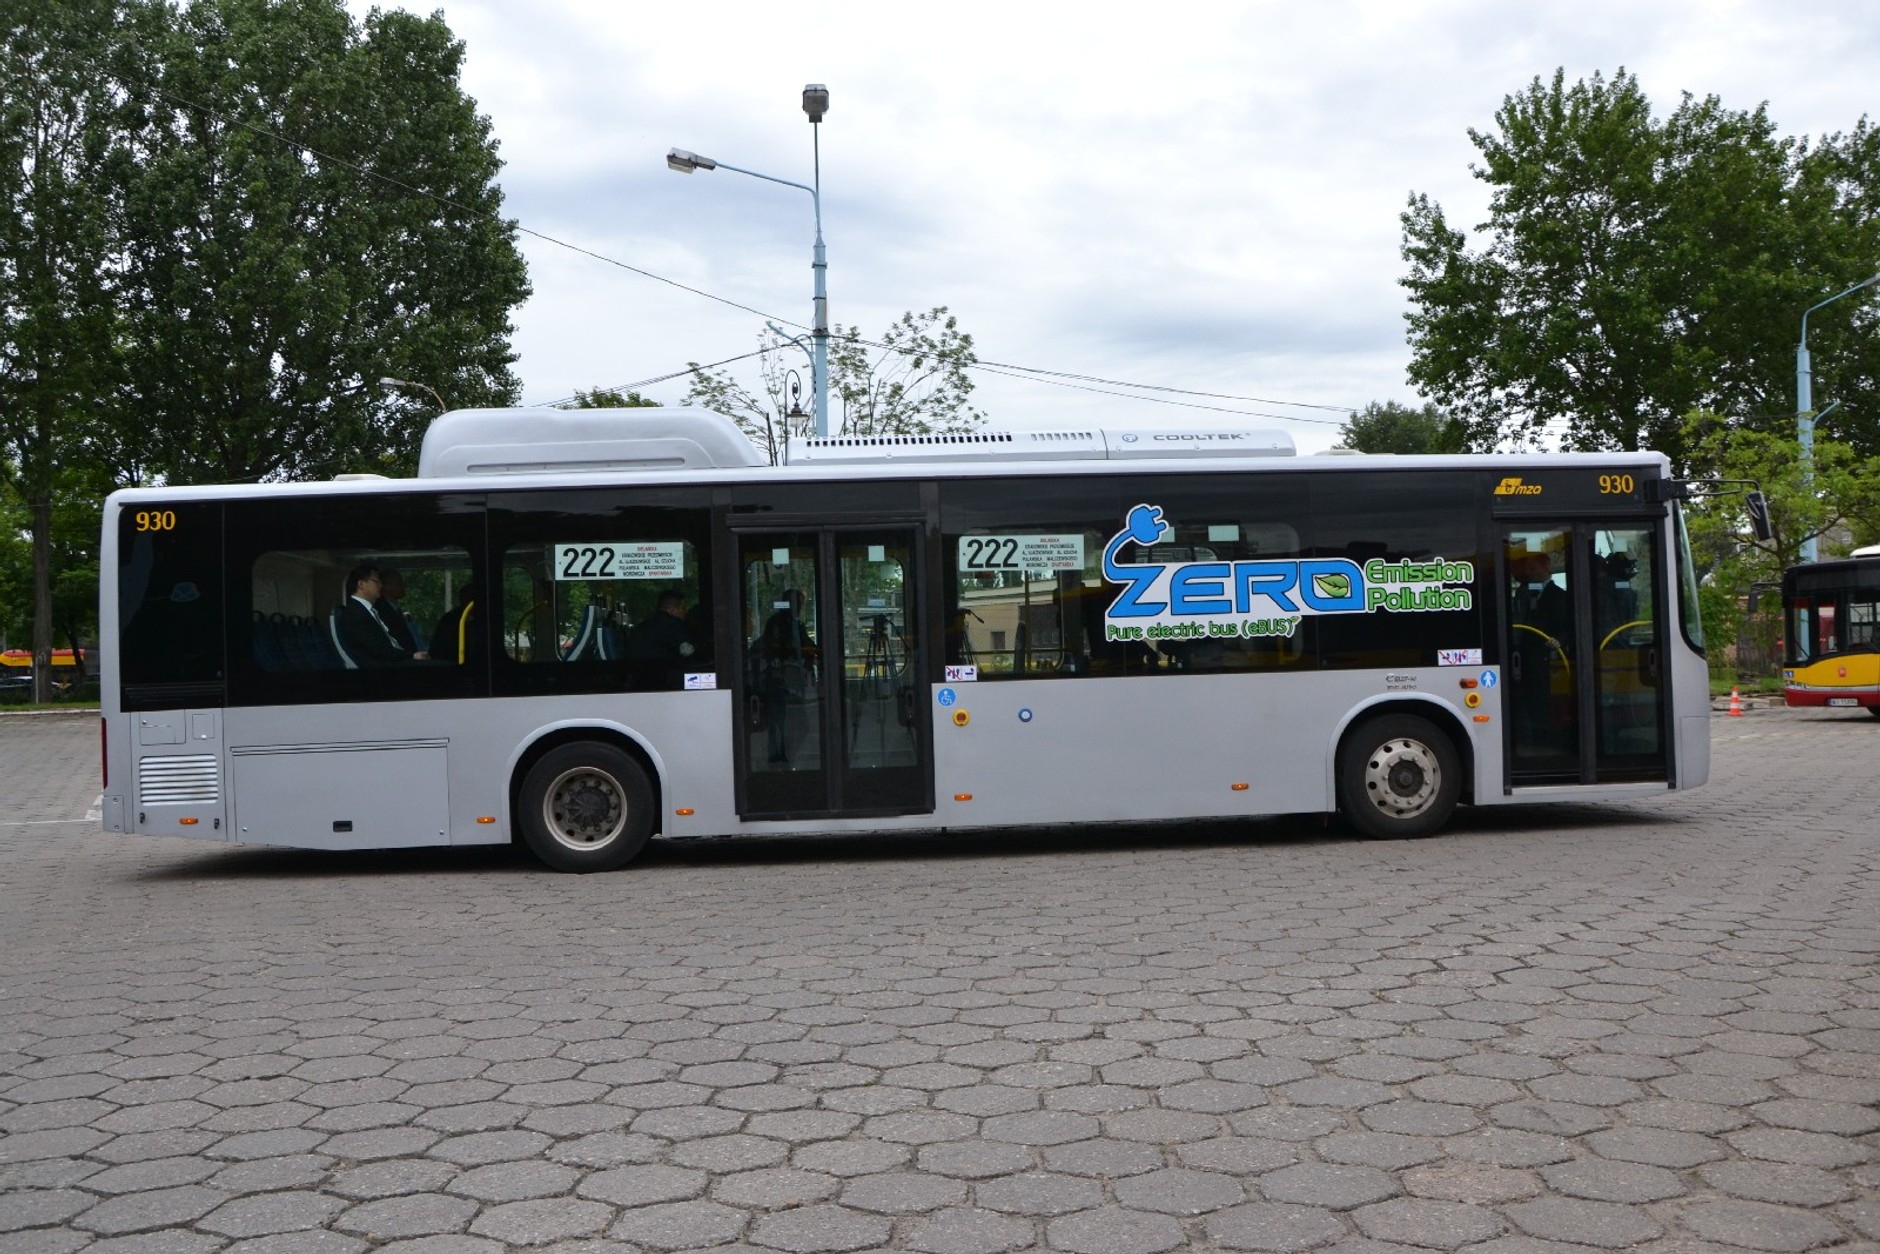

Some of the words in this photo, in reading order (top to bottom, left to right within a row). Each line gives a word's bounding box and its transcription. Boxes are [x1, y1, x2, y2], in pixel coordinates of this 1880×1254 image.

[1153, 433, 1244, 441] COOLTEK
[1599, 474, 1634, 494] 930
[136, 511, 176, 531] 930
[562, 547, 616, 577] 222
[967, 538, 1019, 569] 222
[1366, 559, 1473, 583] Emission
[1104, 559, 1366, 618] ZERO
[1367, 586, 1470, 611] Pollution
[1107, 624, 1143, 640] Pure
[1147, 621, 1206, 638] electric
[1208, 620, 1238, 636] bus
[1241, 618, 1294, 639] (eBUS)
